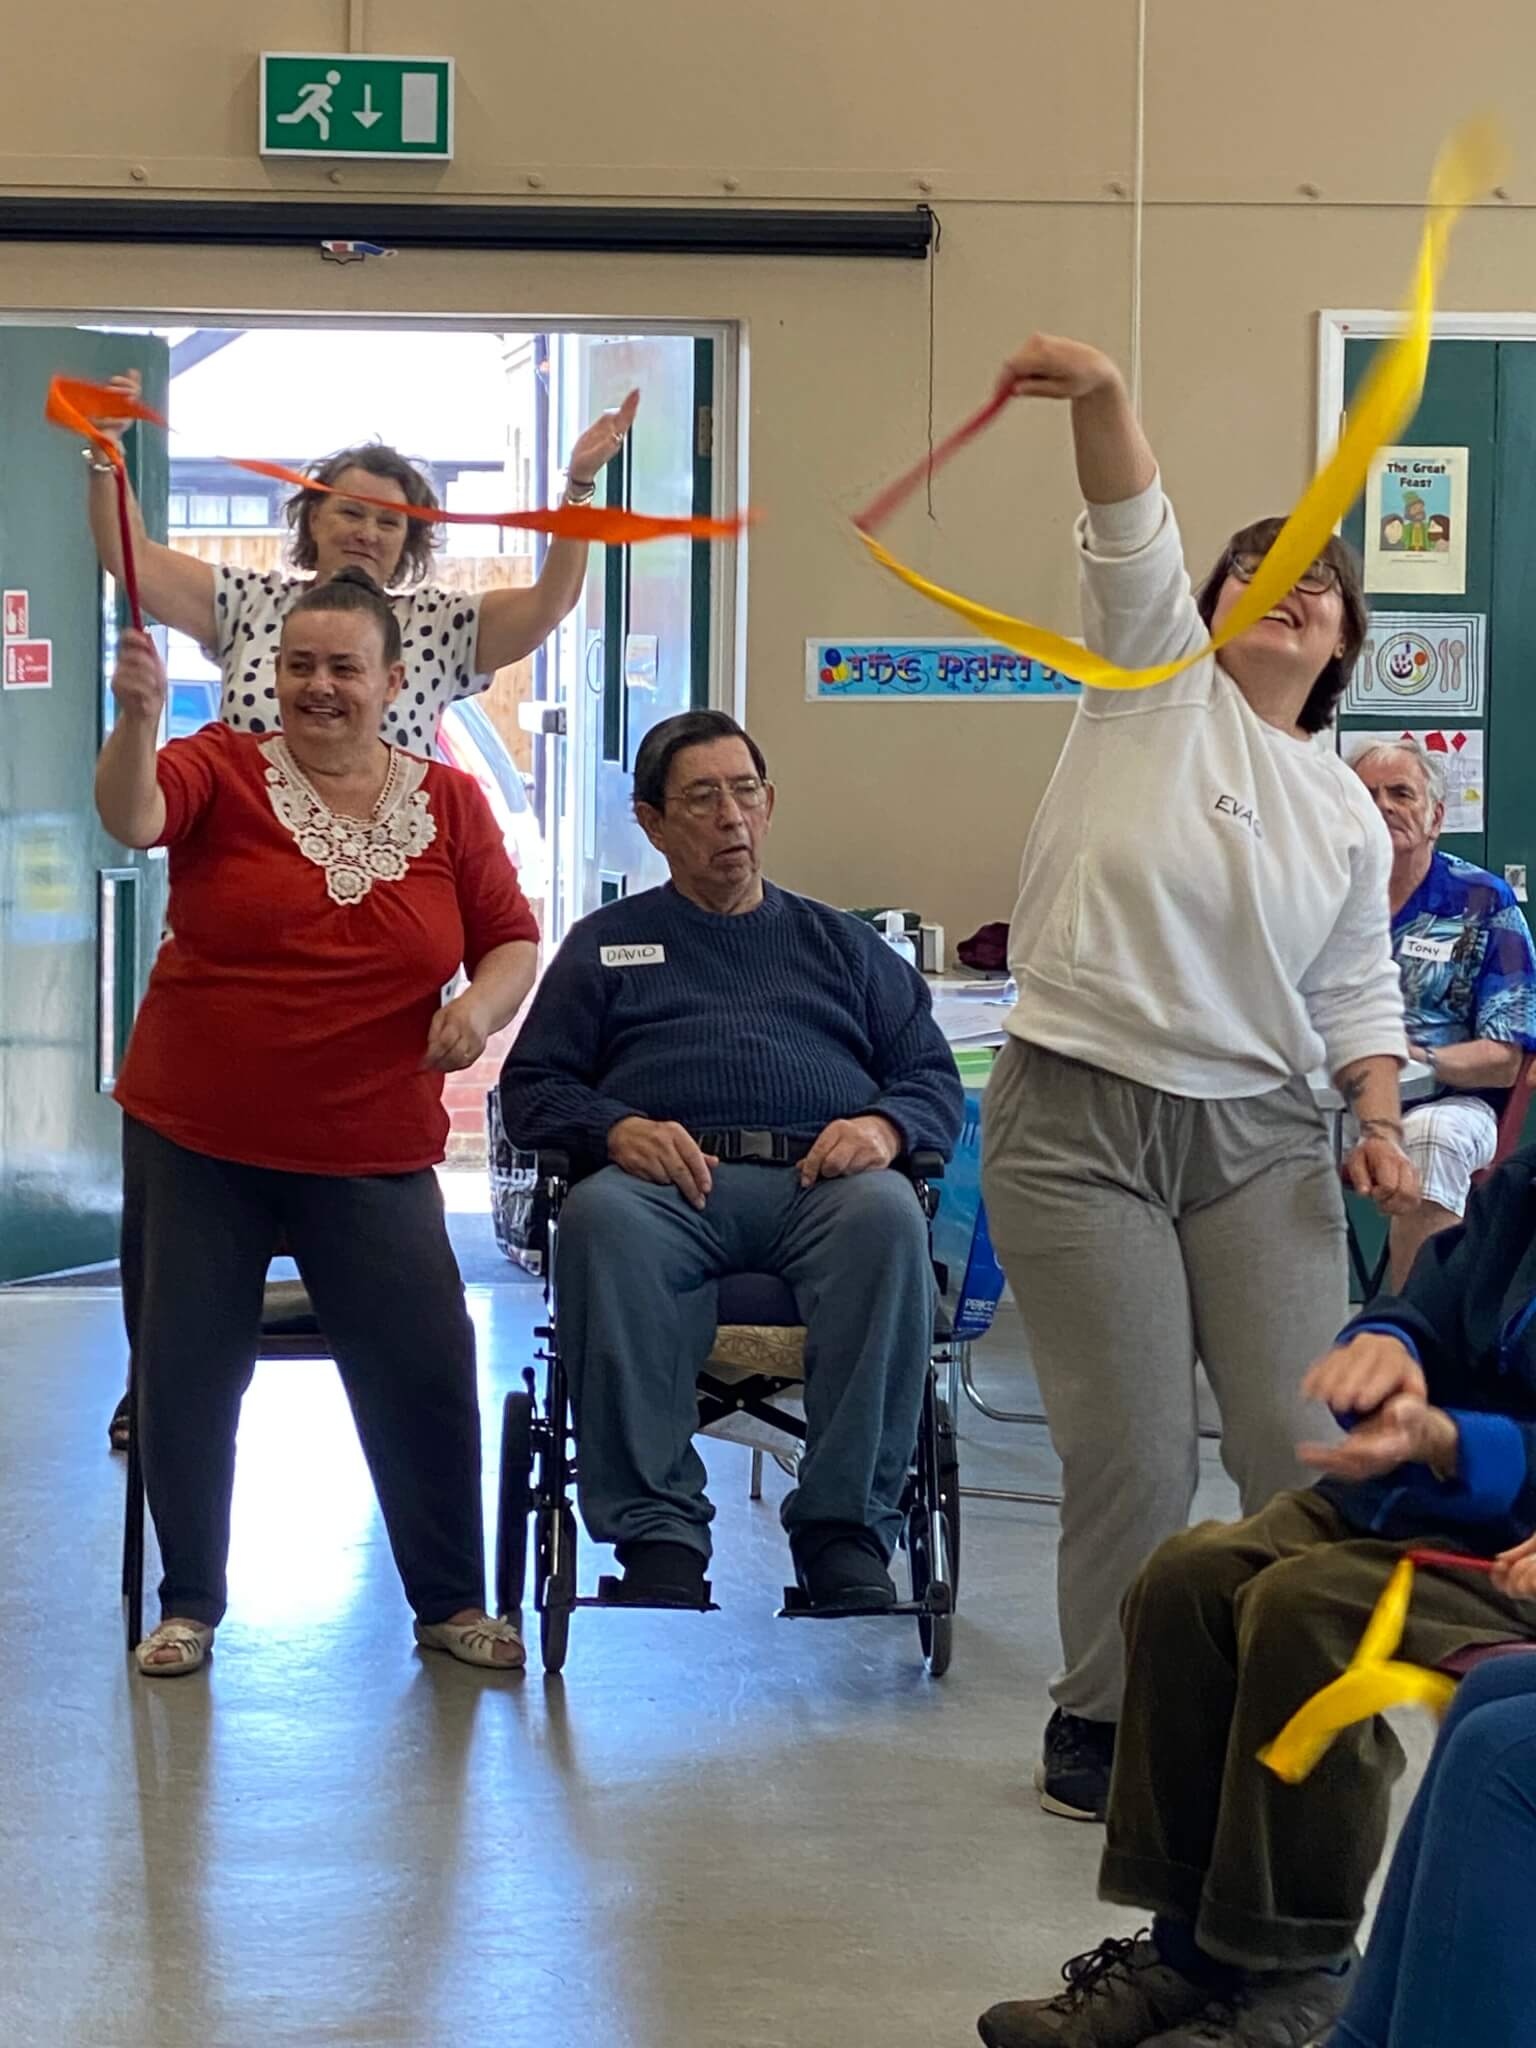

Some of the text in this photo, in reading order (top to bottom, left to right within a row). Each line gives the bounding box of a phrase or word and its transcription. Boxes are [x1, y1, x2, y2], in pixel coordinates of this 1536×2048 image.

[1387, 462, 1446, 474] The Great
[1400, 477, 1432, 488] Feast
[606, 946, 657, 963] DAVID
